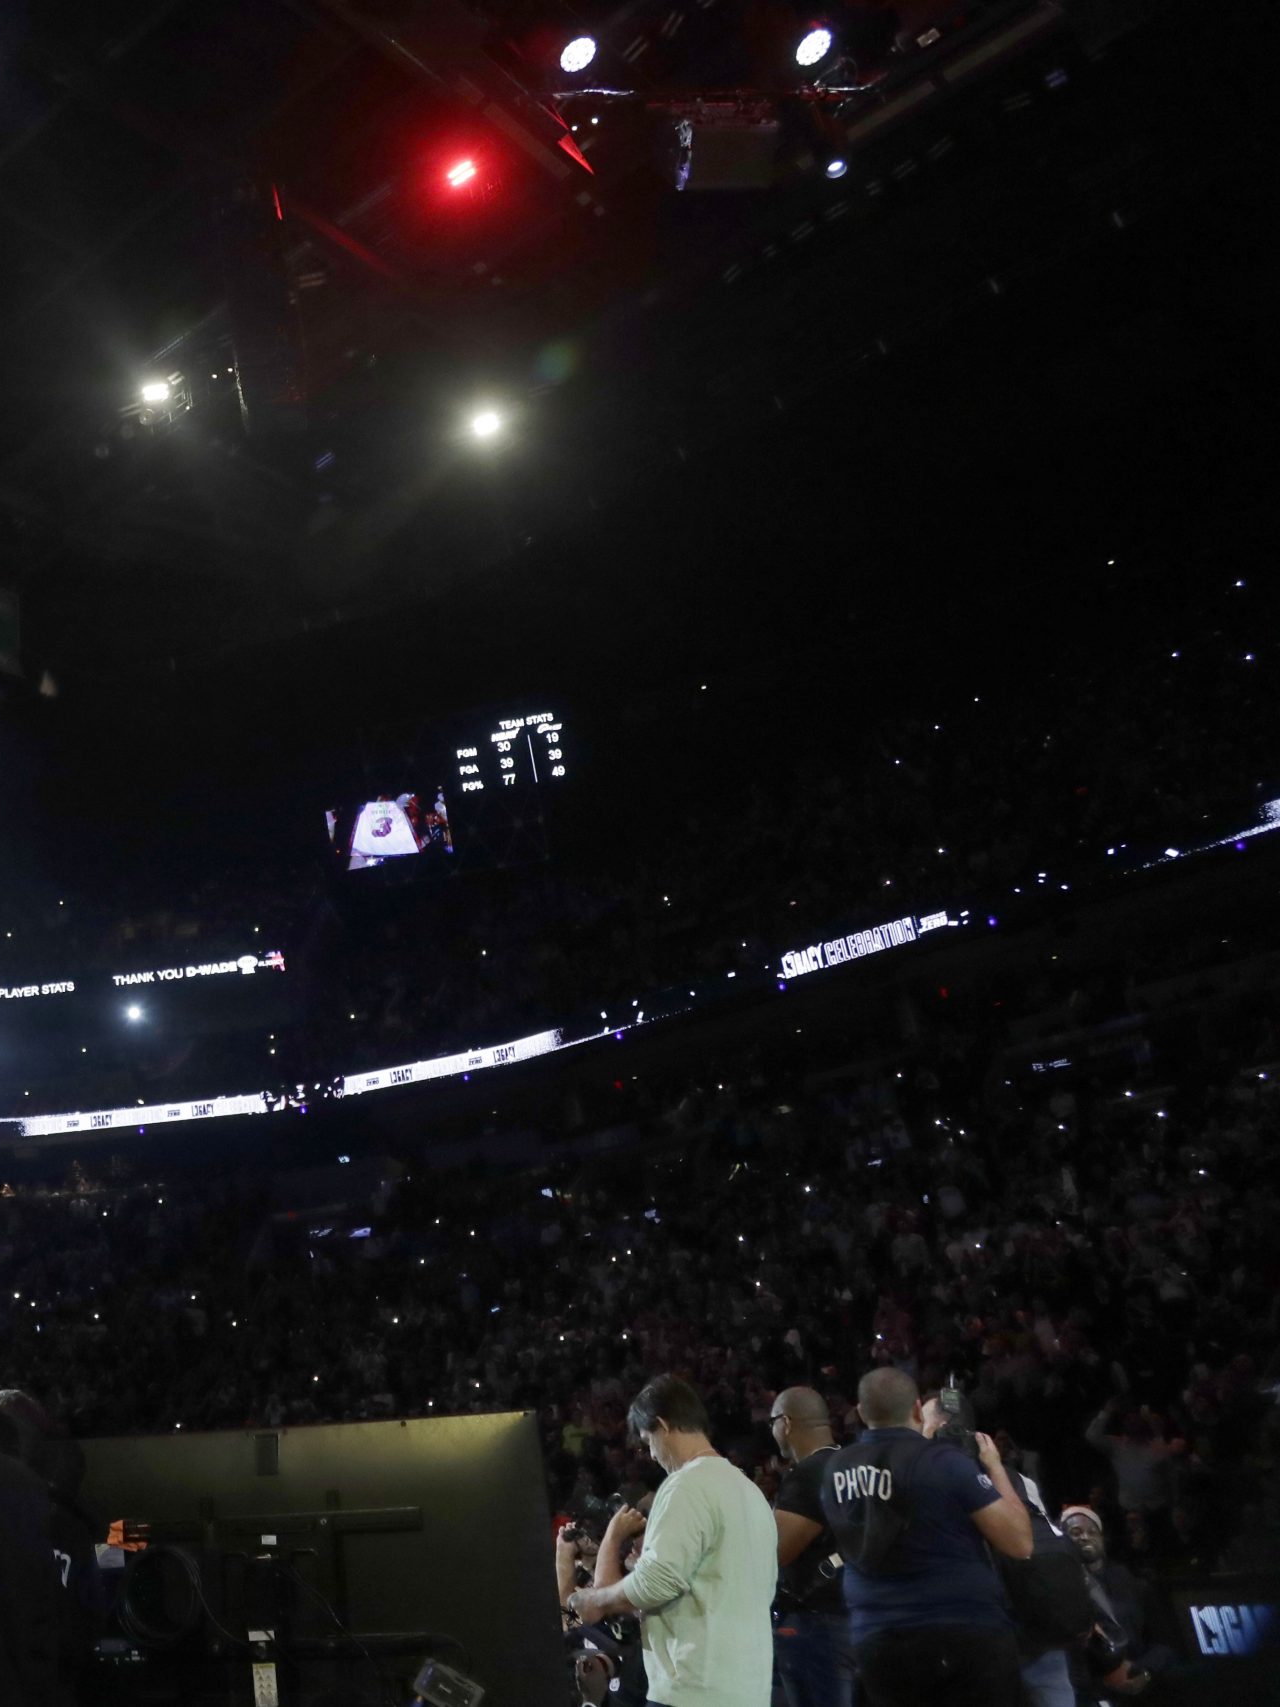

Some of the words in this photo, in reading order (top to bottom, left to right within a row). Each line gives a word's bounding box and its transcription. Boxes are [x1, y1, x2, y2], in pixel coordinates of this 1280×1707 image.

[499, 718, 525, 730] TEAM
[526, 712, 554, 725] STATS
[497, 740, 511, 752] 30
[546, 732, 559, 744] 19
[459, 764, 479, 776] FGA
[499, 757, 514, 769] 39
[548, 748, 562, 760] 39
[462, 780, 484, 792] FG%
[502, 773, 516, 786] 77
[551, 765, 565, 777] 49
[371, 816, 393, 838] 3
[824, 916, 916, 966] CELEBRATION
[112, 971, 155, 986] THANK
[157, 967, 183, 981] YOU
[185, 960, 238, 978] D-WADE
[41, 981, 75, 995] STATS
[833, 1464, 892, 1504] PHOTO
